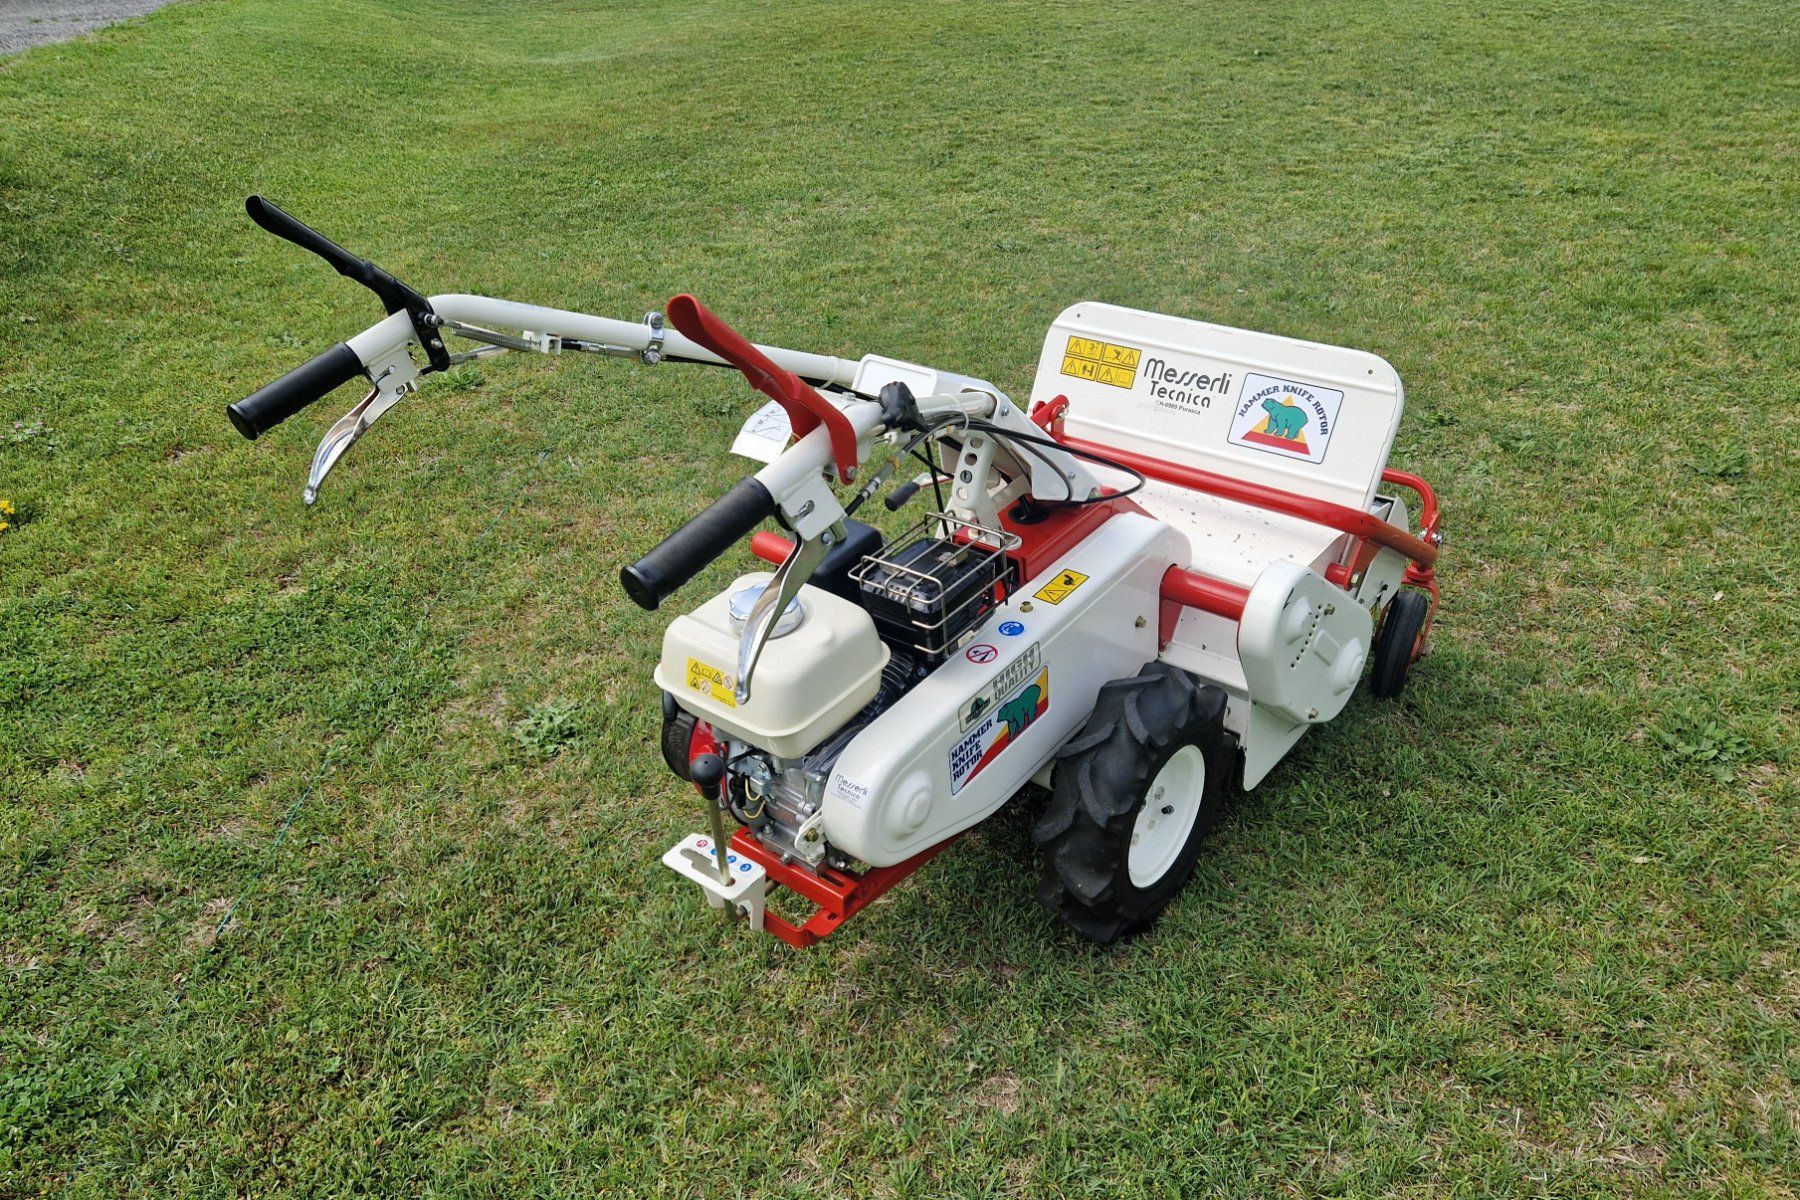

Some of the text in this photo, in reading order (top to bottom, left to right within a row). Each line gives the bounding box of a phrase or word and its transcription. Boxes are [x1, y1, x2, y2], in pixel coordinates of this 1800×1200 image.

[1143, 358, 1232, 394] Messerli
[1150, 380, 1211, 408] Tecnica
[1238, 385, 1329, 436] HAMMER KNIFE ROTOR
[992, 648, 1035, 690] HIGH
[994, 659, 1035, 701] QUALITY
[951, 719, 992, 761] HAMMER
[952, 740, 981, 772] KNIFE
[953, 749, 983, 782] ROTOR
[835, 773, 868, 796] Messerli
[837, 783, 861, 800] Tecnica
